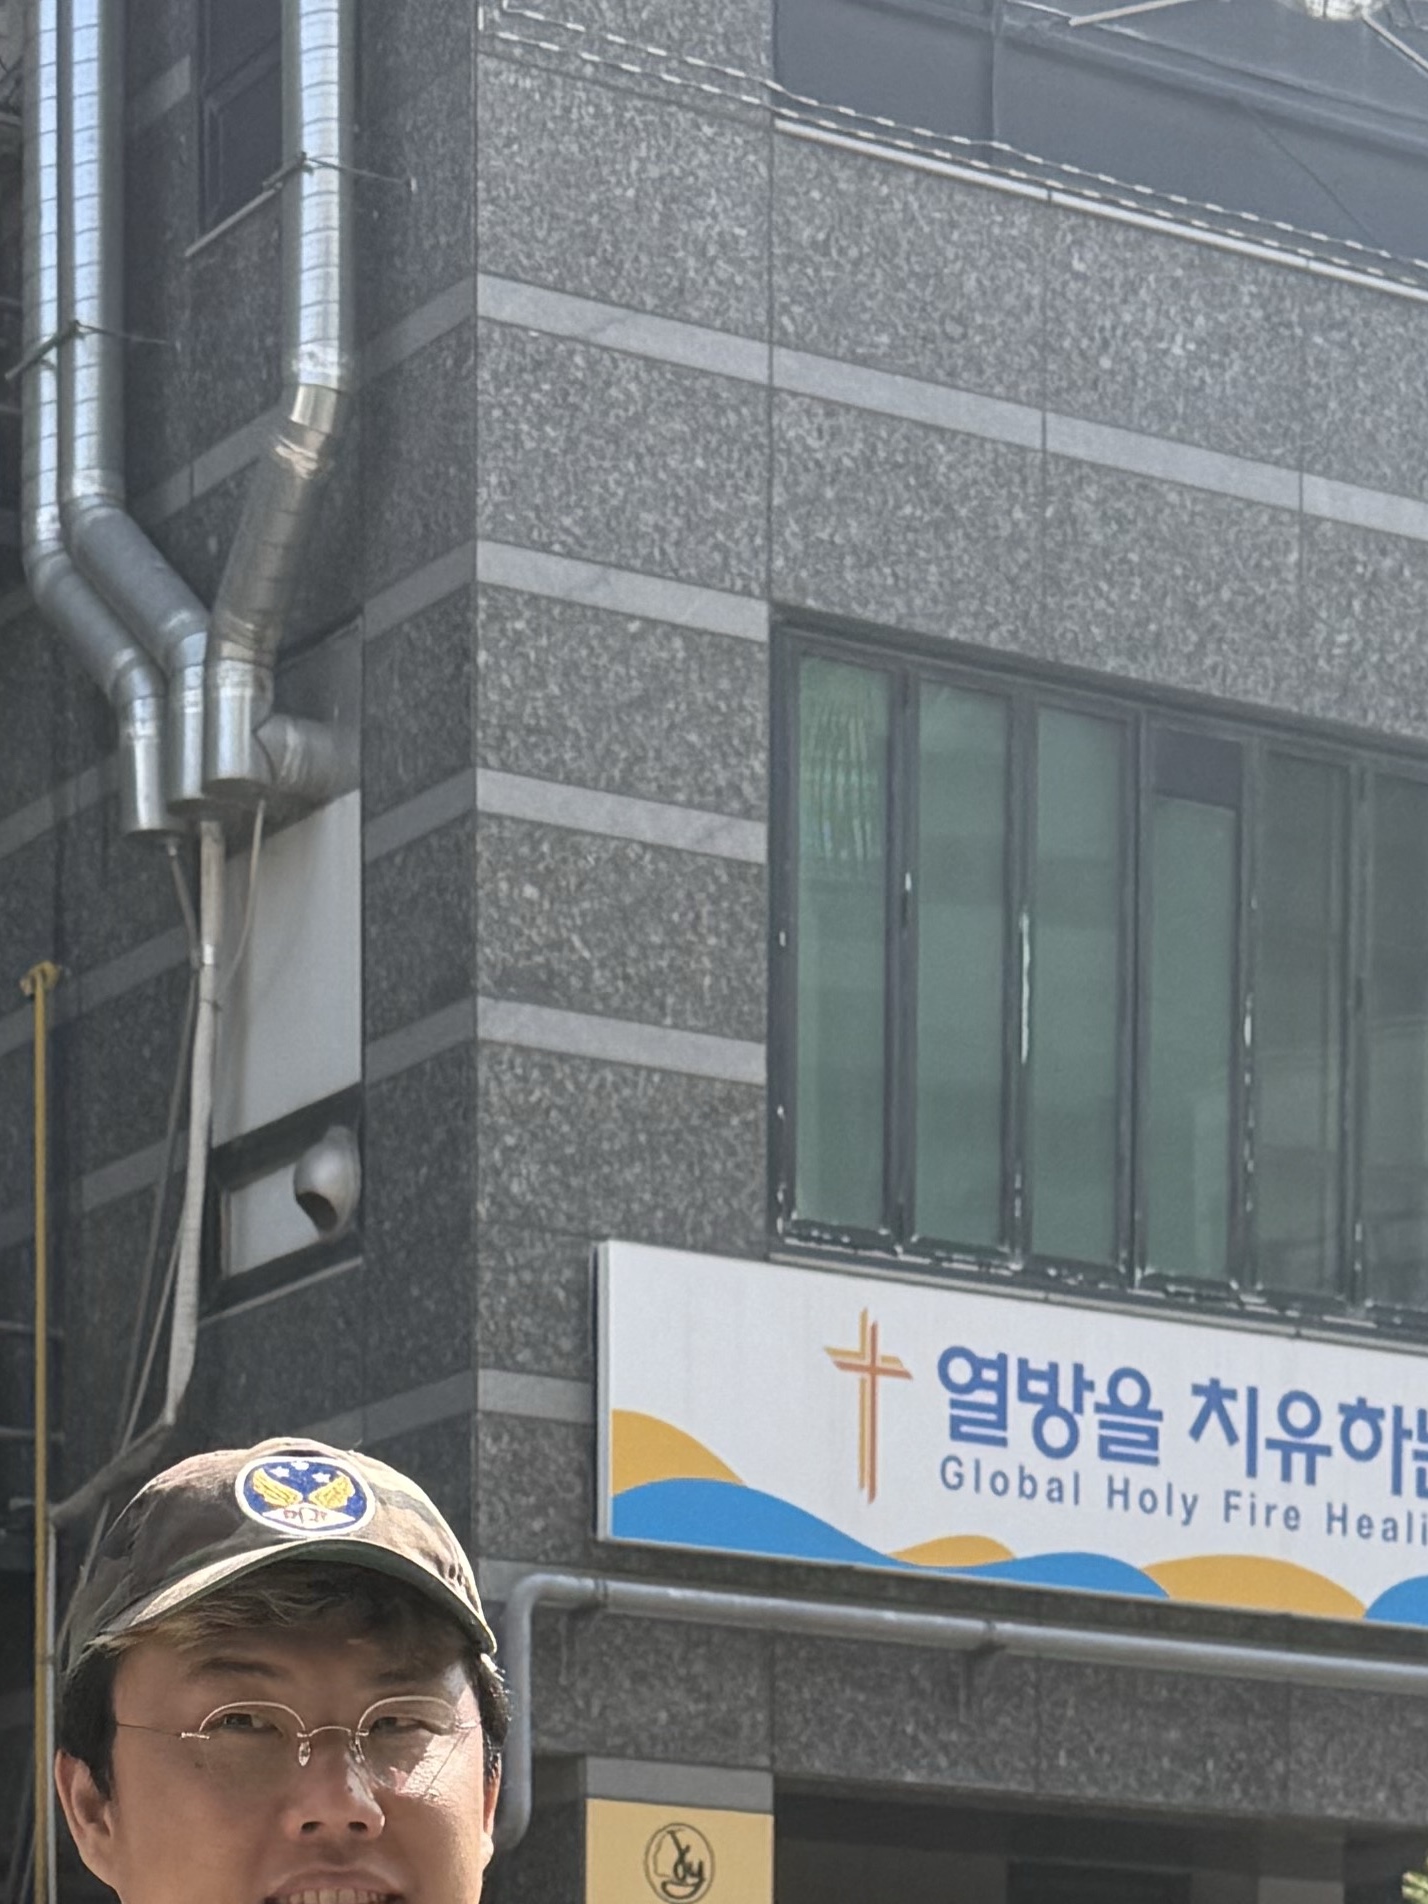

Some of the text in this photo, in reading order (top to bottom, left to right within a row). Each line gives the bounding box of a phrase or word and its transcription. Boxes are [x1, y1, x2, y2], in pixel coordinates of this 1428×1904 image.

[937, 1345, 1164, 1467] 열방을
[940, 1454, 1081, 1506] Global
[1107, 1474, 1200, 1527] Holy
[1223, 1489, 1301, 1532] Fire
